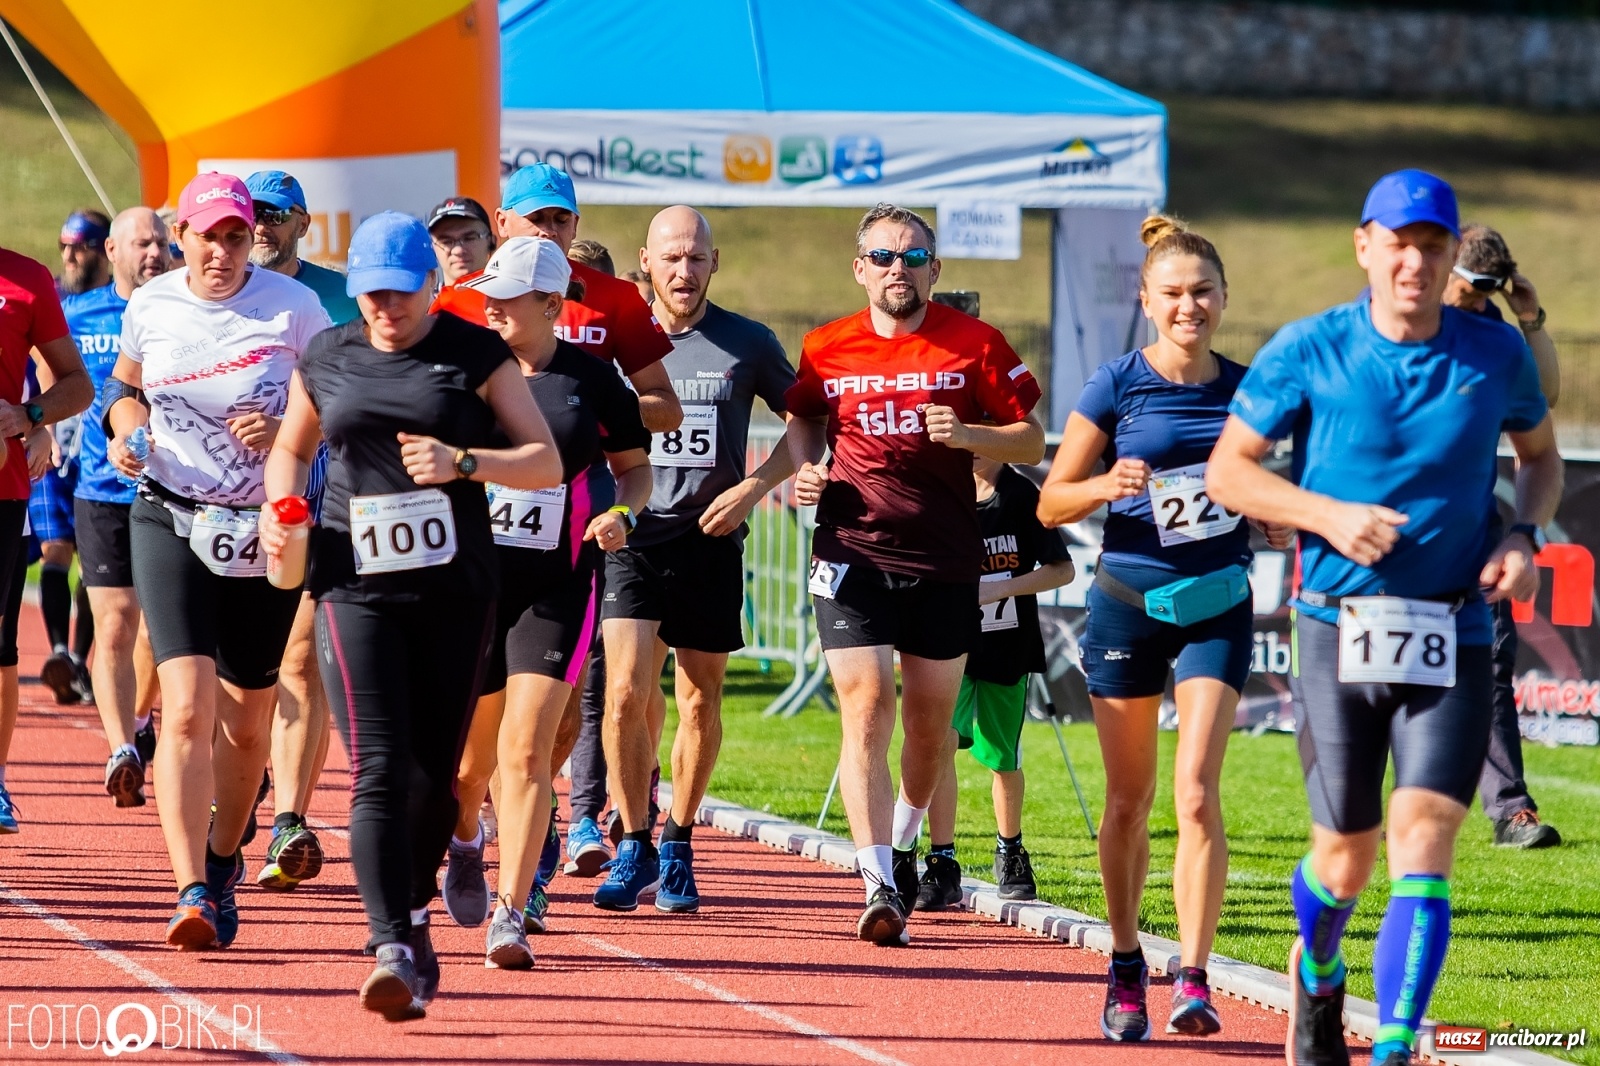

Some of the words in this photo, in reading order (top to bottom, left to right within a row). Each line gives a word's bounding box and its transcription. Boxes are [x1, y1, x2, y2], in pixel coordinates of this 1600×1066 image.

[195, 187, 248, 206] adidas
[170, 338, 208, 360] GRYF
[696, 370, 725, 379] Reebok
[823, 371, 966, 399] DAR-BUD
[670, 378, 734, 401] ARTAN
[661, 428, 711, 456] 85
[490, 502, 543, 536] 44
[211, 532, 260, 566] 64
[360, 517, 447, 558] 100
[1352, 629, 1447, 668] 178
